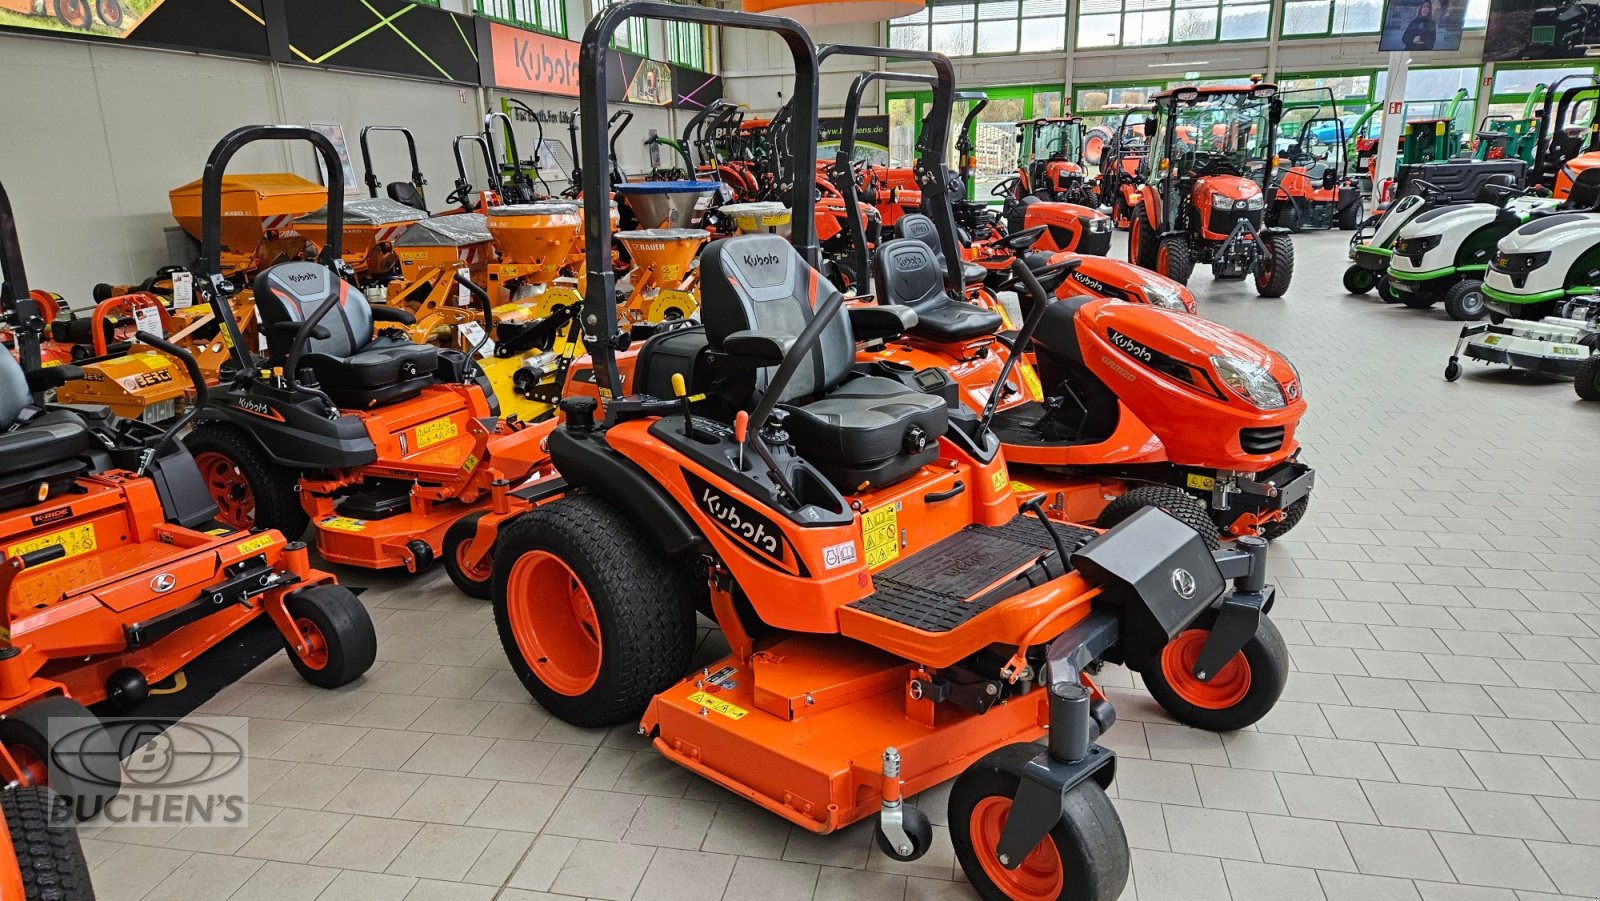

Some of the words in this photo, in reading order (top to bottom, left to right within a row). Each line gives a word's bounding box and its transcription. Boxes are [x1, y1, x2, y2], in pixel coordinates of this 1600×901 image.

[743, 253, 780, 267] Kubota
[288, 273, 317, 283] Kubota
[1074, 272, 1103, 291] Kubota
[1112, 332, 1152, 362] Kubota
[238, 398, 268, 414] Kubota
[34, 508, 69, 522] K-RIDE
[702, 488, 778, 553] Kubota
